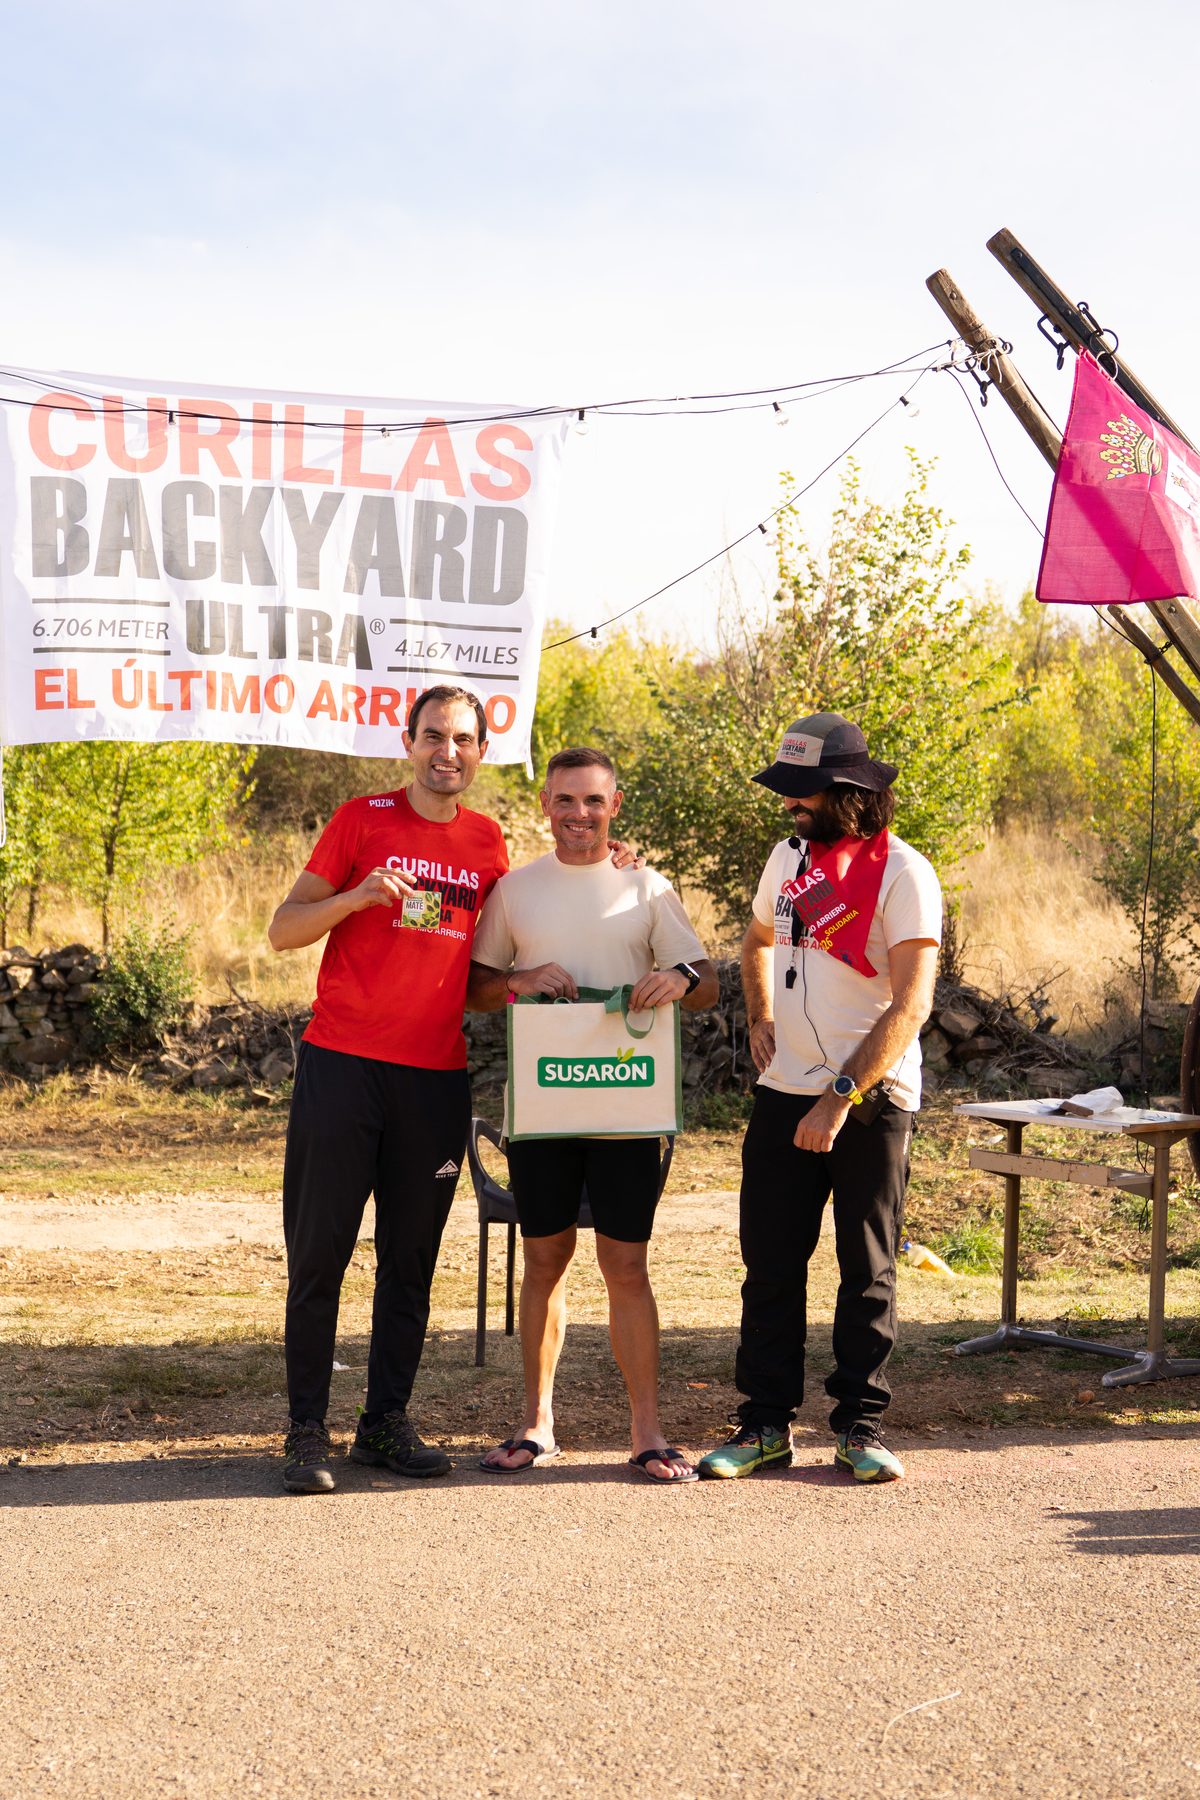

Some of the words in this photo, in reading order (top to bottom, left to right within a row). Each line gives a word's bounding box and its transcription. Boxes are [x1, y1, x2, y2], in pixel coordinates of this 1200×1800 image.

[28, 392, 534, 502] CURILLAS
[30, 476, 529, 606] BACKYARD
[33, 618, 93, 638] 6.706
[98, 619, 169, 640] METER
[394, 639, 452, 661] 4.167
[455, 644, 519, 665] MILES
[34, 668, 96, 711] EL
[112, 658, 295, 715] ÚLTIMO
[306, 680, 517, 735] ARRIO
[386, 856, 479, 889] CURILLAS
[816, 903, 847, 928] ARRIERO
[824, 909, 860, 937] SOLIDARIA
[434, 927, 467, 940] ARRIERO
